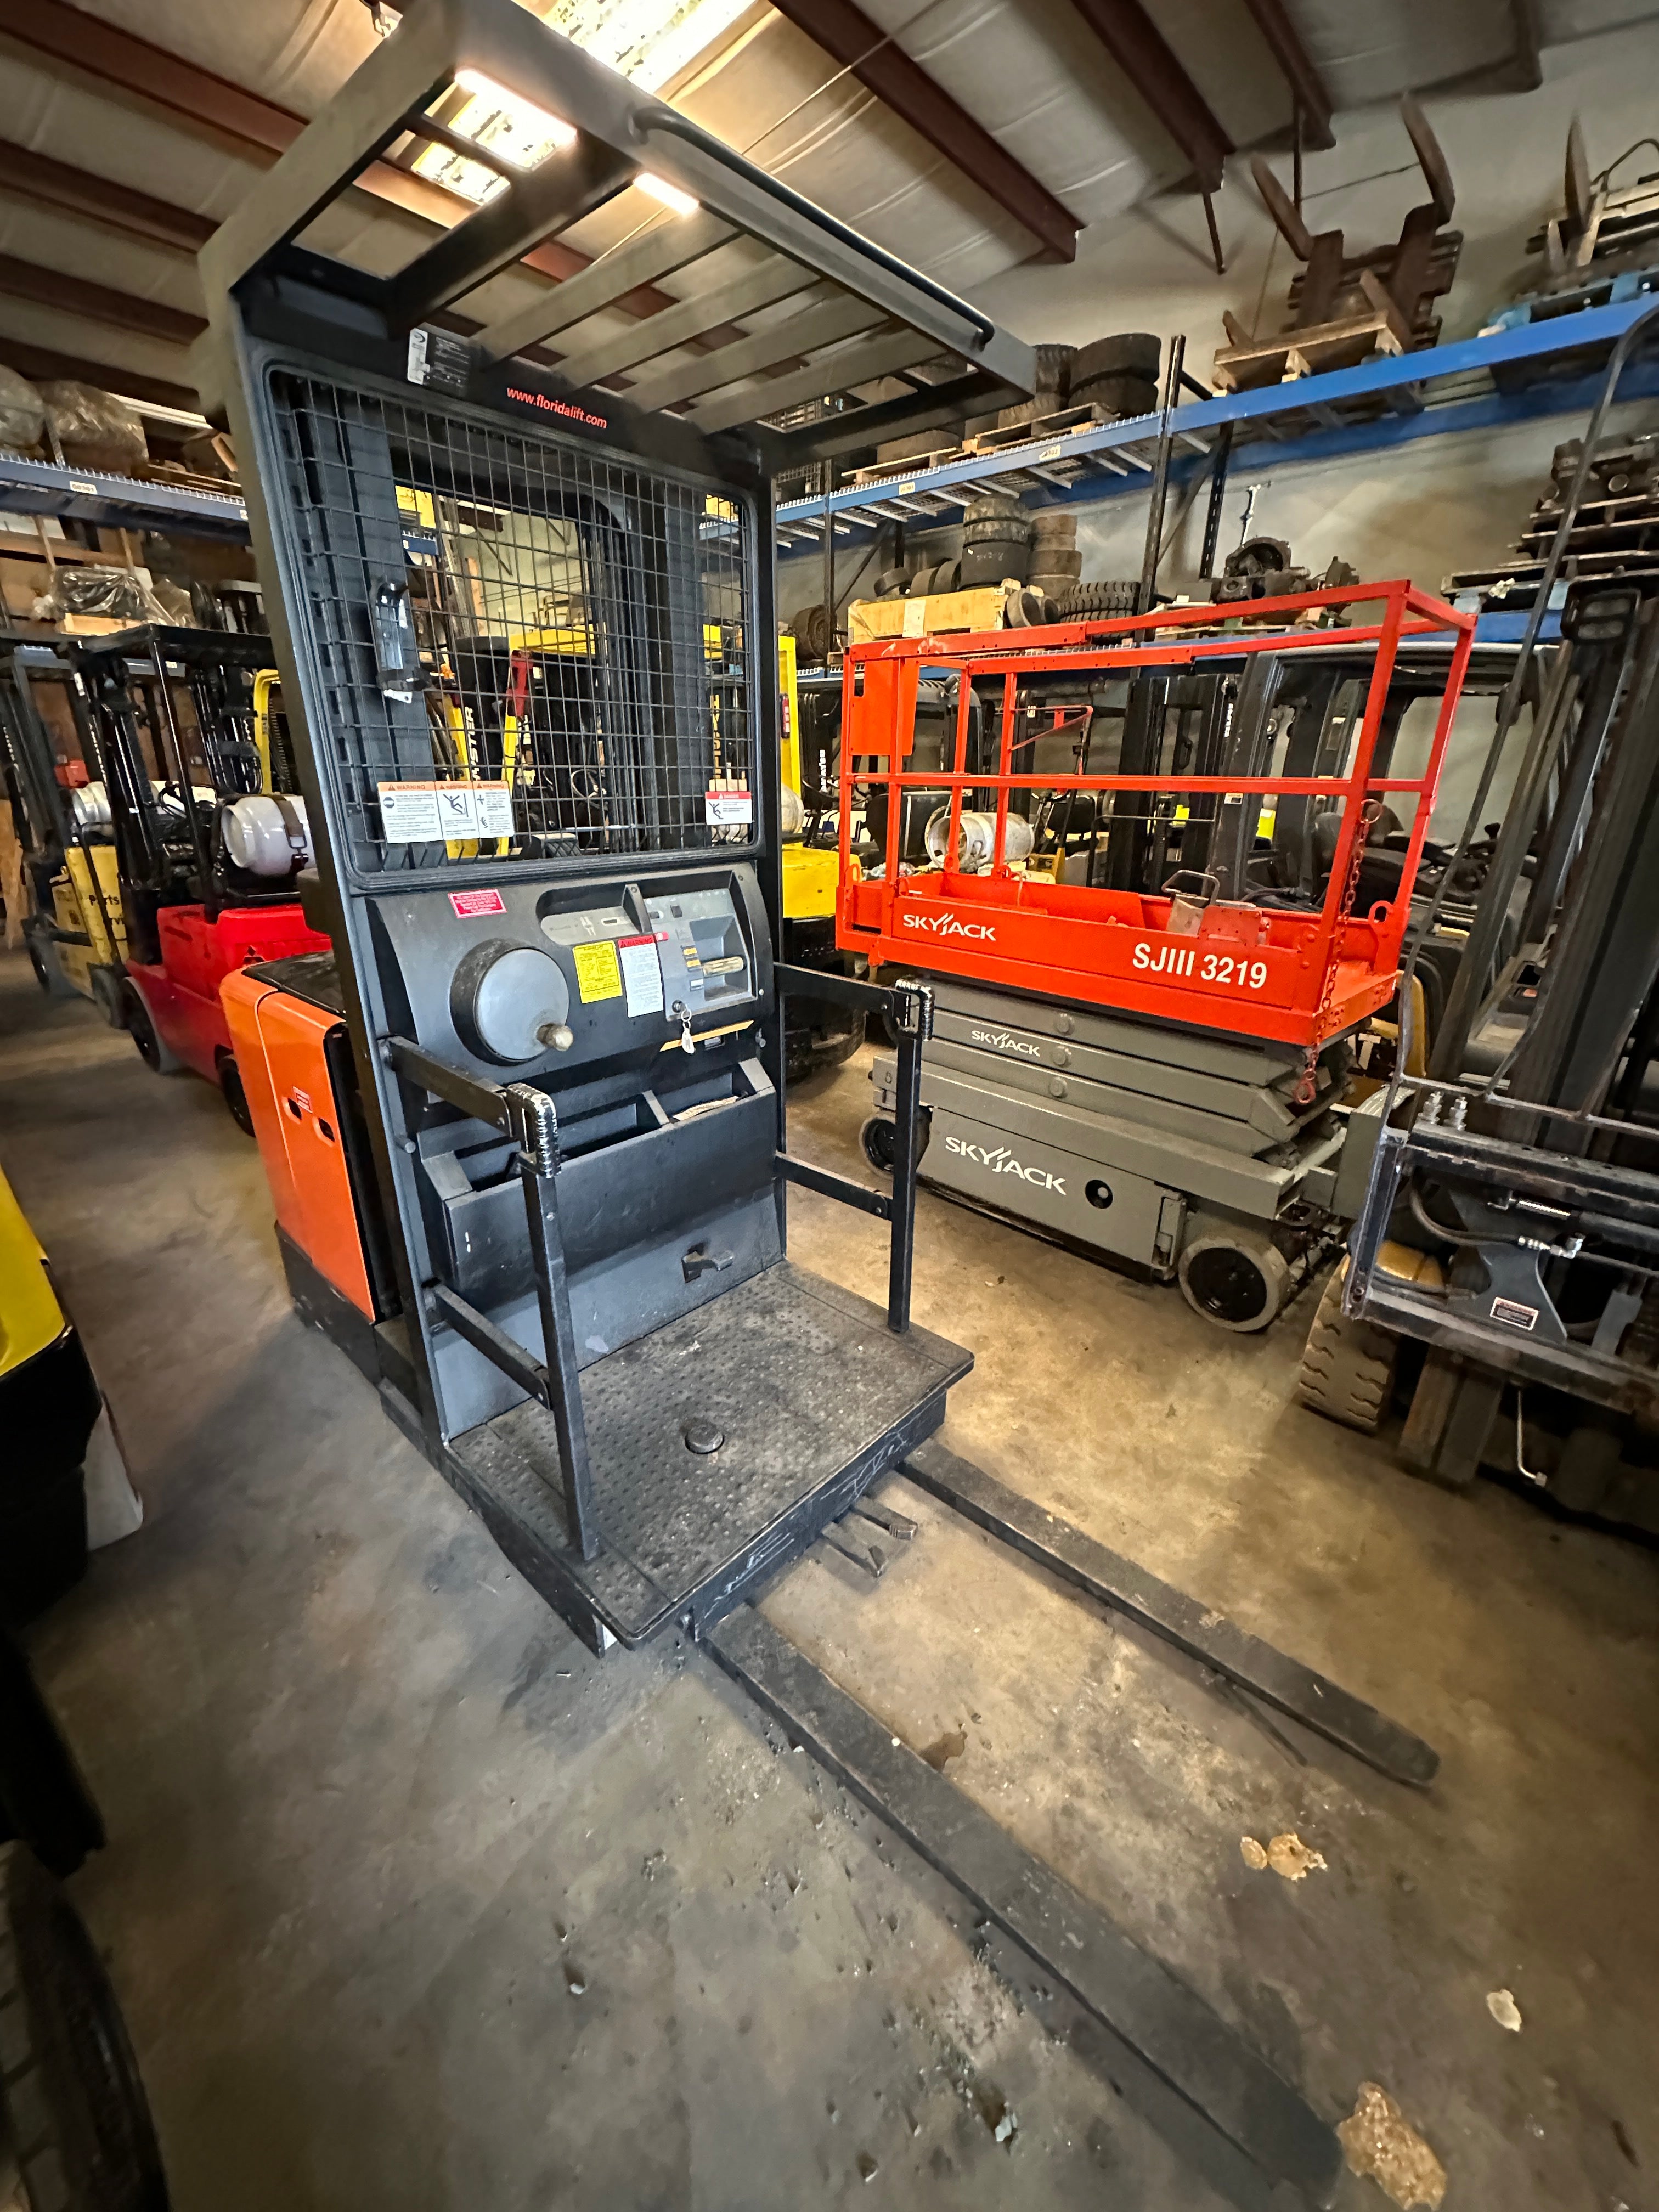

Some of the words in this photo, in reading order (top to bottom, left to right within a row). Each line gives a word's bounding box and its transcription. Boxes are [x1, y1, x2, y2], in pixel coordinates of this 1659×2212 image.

[506, 387, 608, 429] www.floridalift.com
[627, 938, 653, 947] WARNING
[902, 912, 997, 941] SKYJACK
[1132, 943, 1195, 977] SJIII
[1200, 954, 1267, 989] 3219
[971, 1030, 1041, 1057] SKYJACK
[945, 1136, 1067, 1195] SKYJACK
